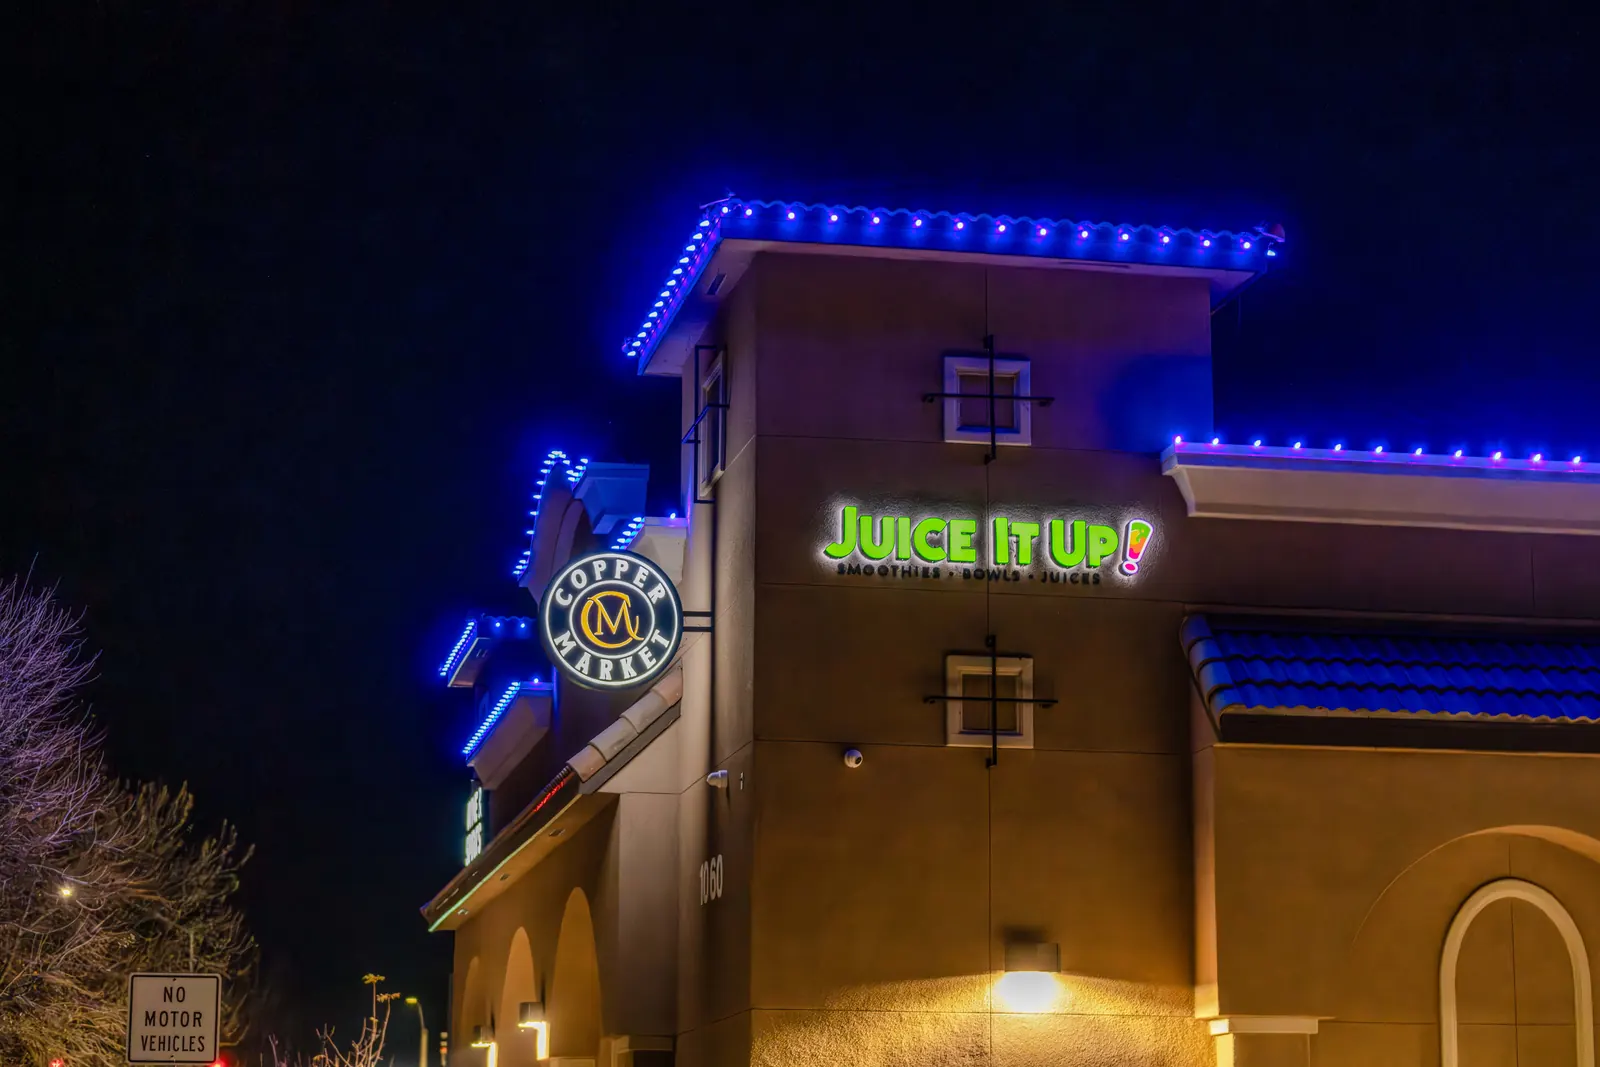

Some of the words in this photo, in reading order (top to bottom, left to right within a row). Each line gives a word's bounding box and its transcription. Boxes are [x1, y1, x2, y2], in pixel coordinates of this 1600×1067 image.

[824, 506, 977, 563] JUICE
[993, 517, 1040, 565] IT
[1051, 518, 1154, 577] UP!
[555, 559, 666, 606] COPPER
[837, 562, 941, 580] SMOOTHIES
[963, 568, 1020, 582] BOWLS
[1041, 571, 1100, 585] JUICES
[553, 628, 670, 680] MARKET
[700, 854, 723, 906] 1060
[163, 986, 186, 1003] NO
[144, 1010, 203, 1028] MOTOR
[141, 1035, 205, 1053] VEHICLES
